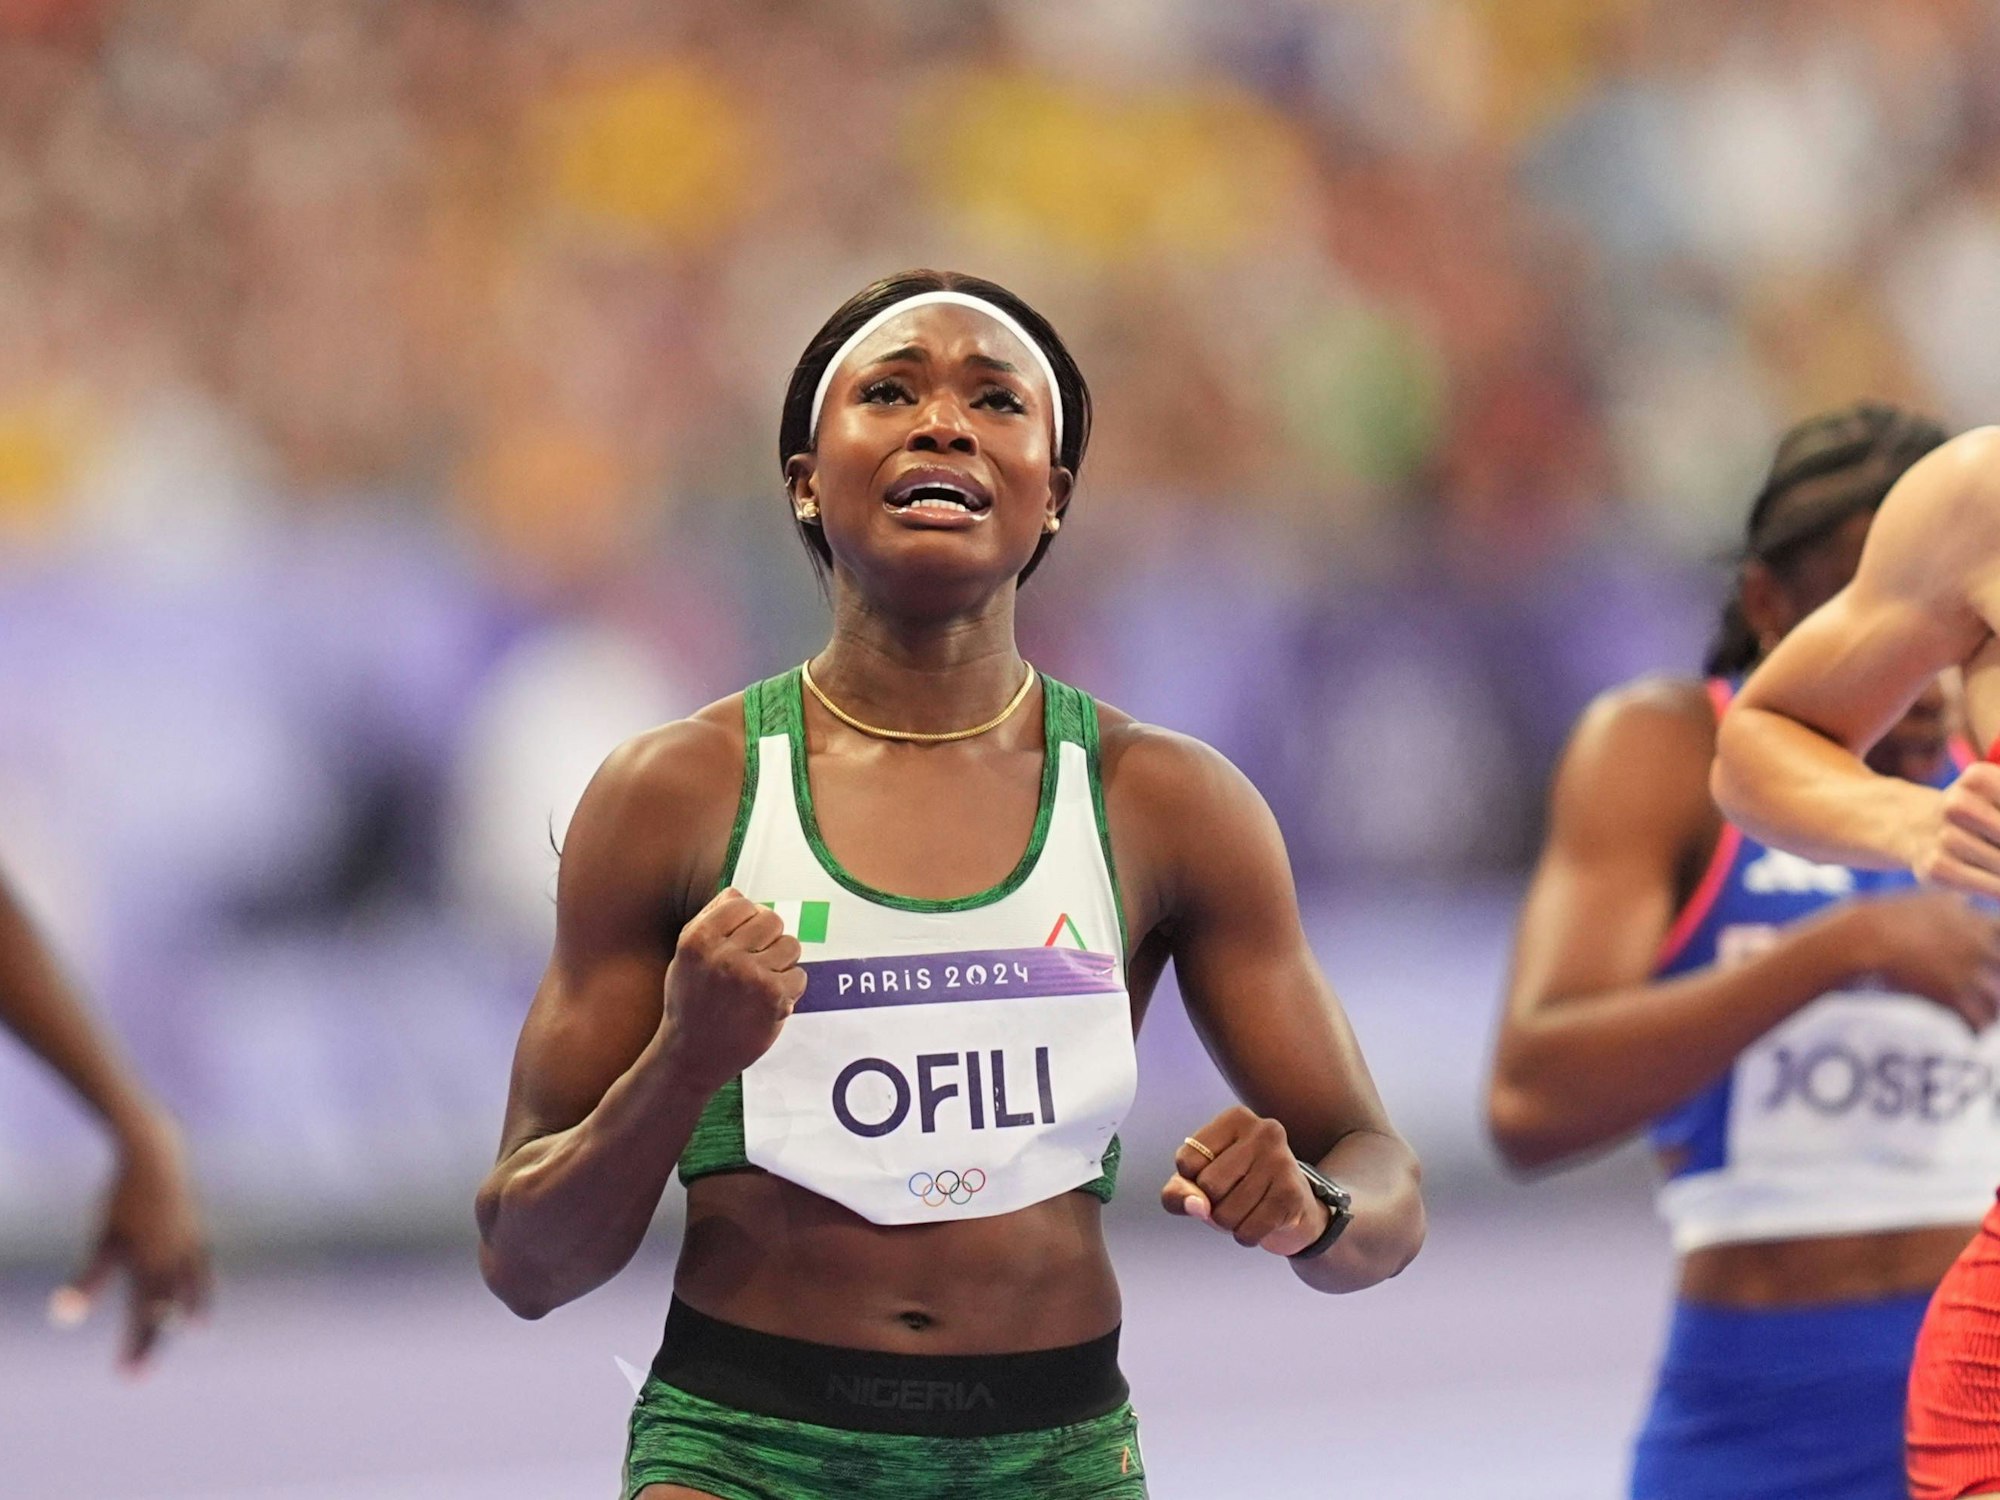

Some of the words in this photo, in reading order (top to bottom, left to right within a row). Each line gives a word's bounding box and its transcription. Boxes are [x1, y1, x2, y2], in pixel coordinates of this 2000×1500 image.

[944, 961, 1029, 988] 2024
[832, 1046, 1056, 1138] OFILI
[1763, 1043, 2000, 1124] JOSEP
[826, 1374, 995, 1411] NIGERIA
